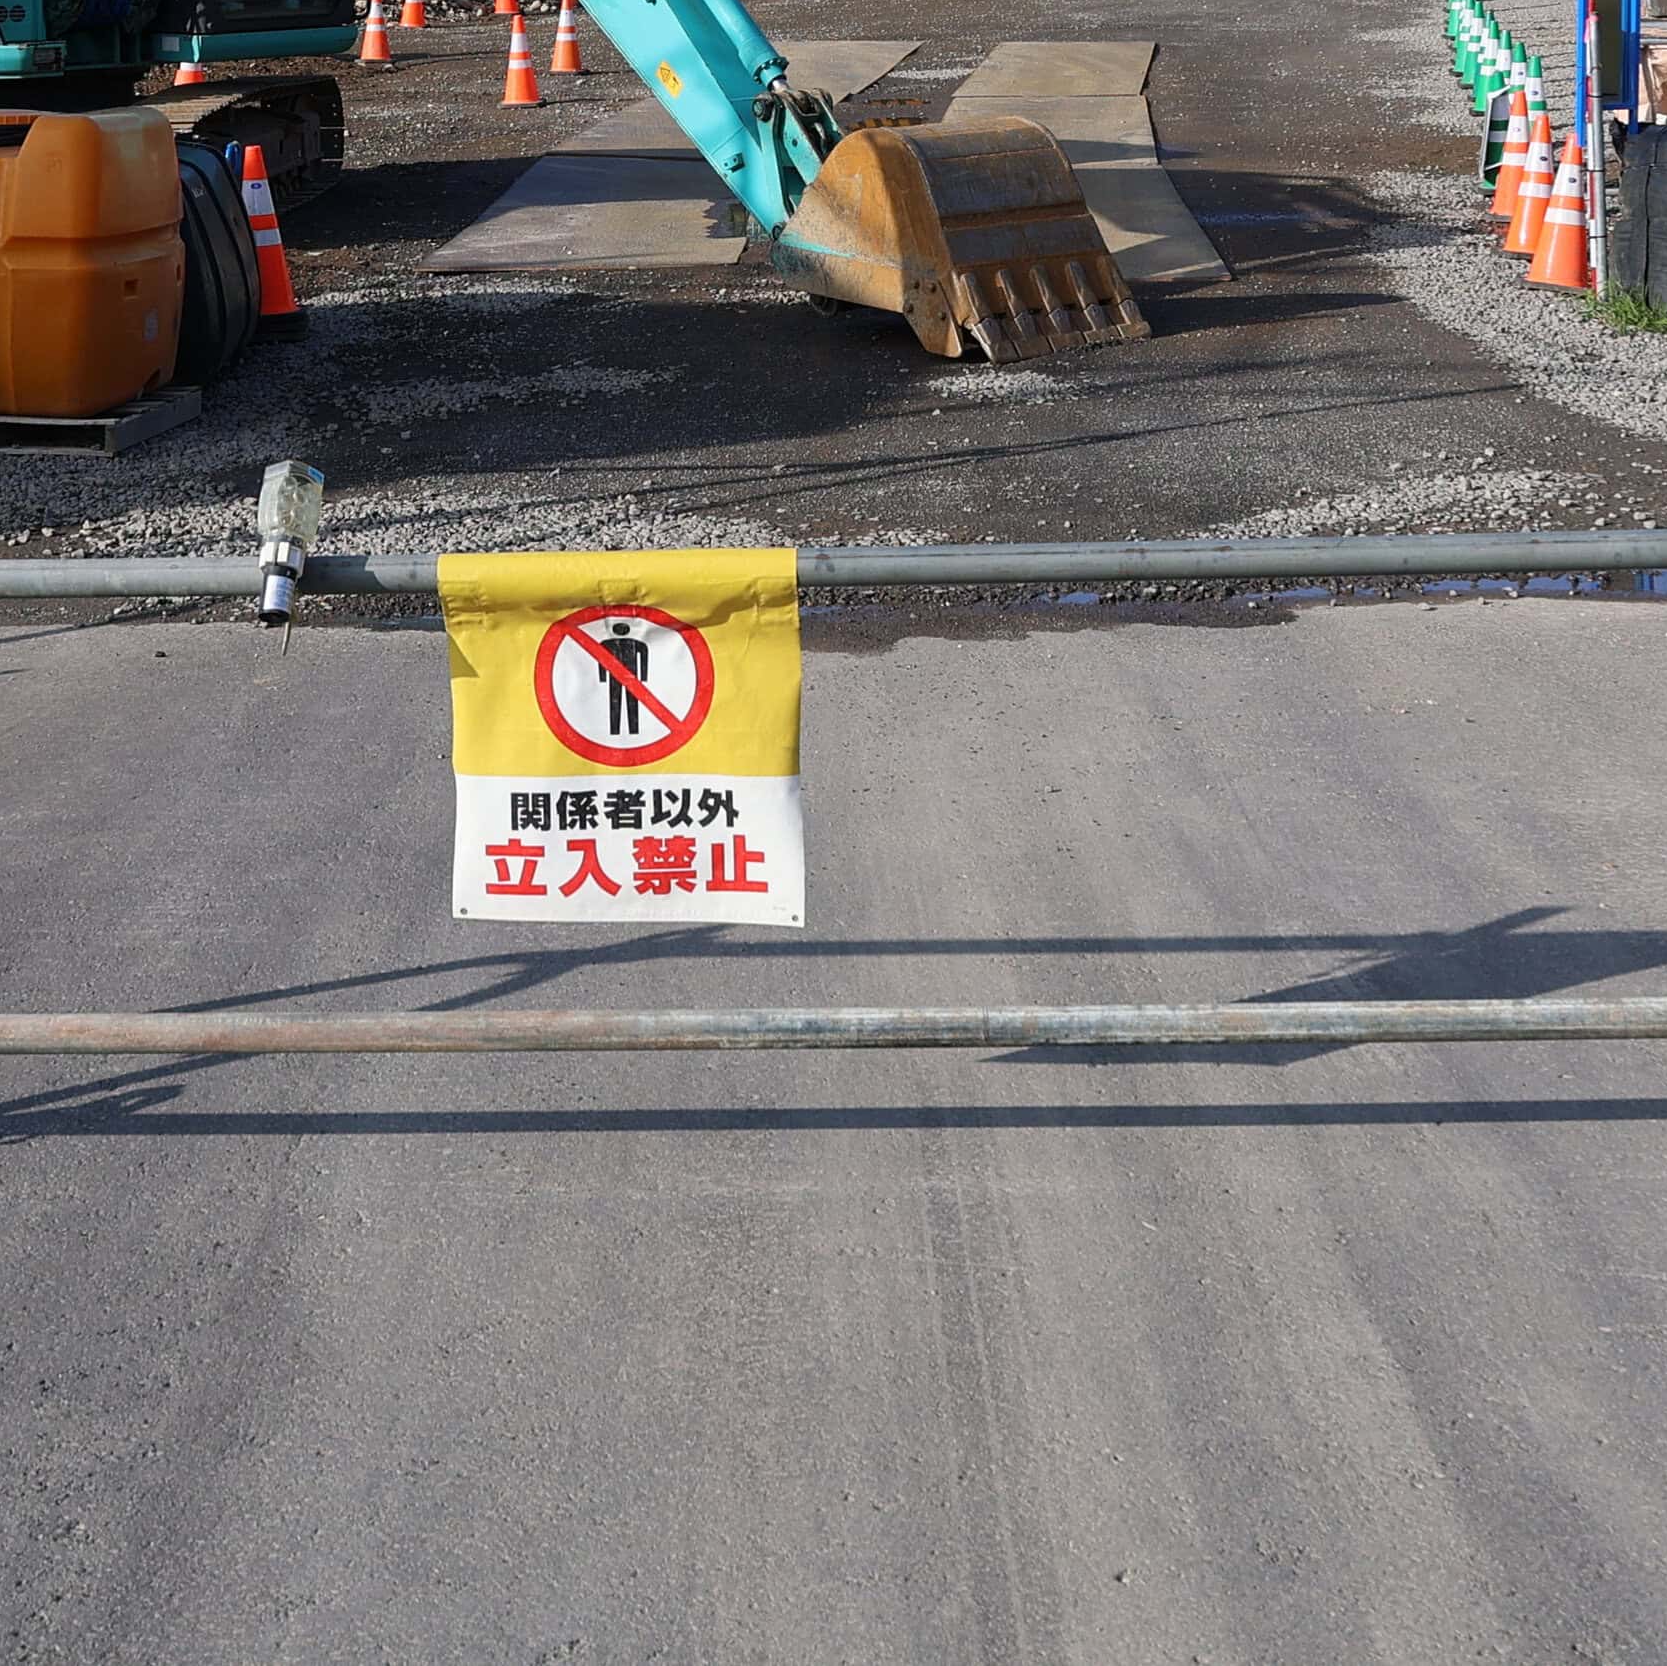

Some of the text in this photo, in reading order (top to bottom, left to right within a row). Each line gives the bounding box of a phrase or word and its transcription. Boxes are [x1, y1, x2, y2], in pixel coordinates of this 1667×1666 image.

[510, 788, 739, 832] 関係者以外
[485, 834, 769, 896] 立入禁止
